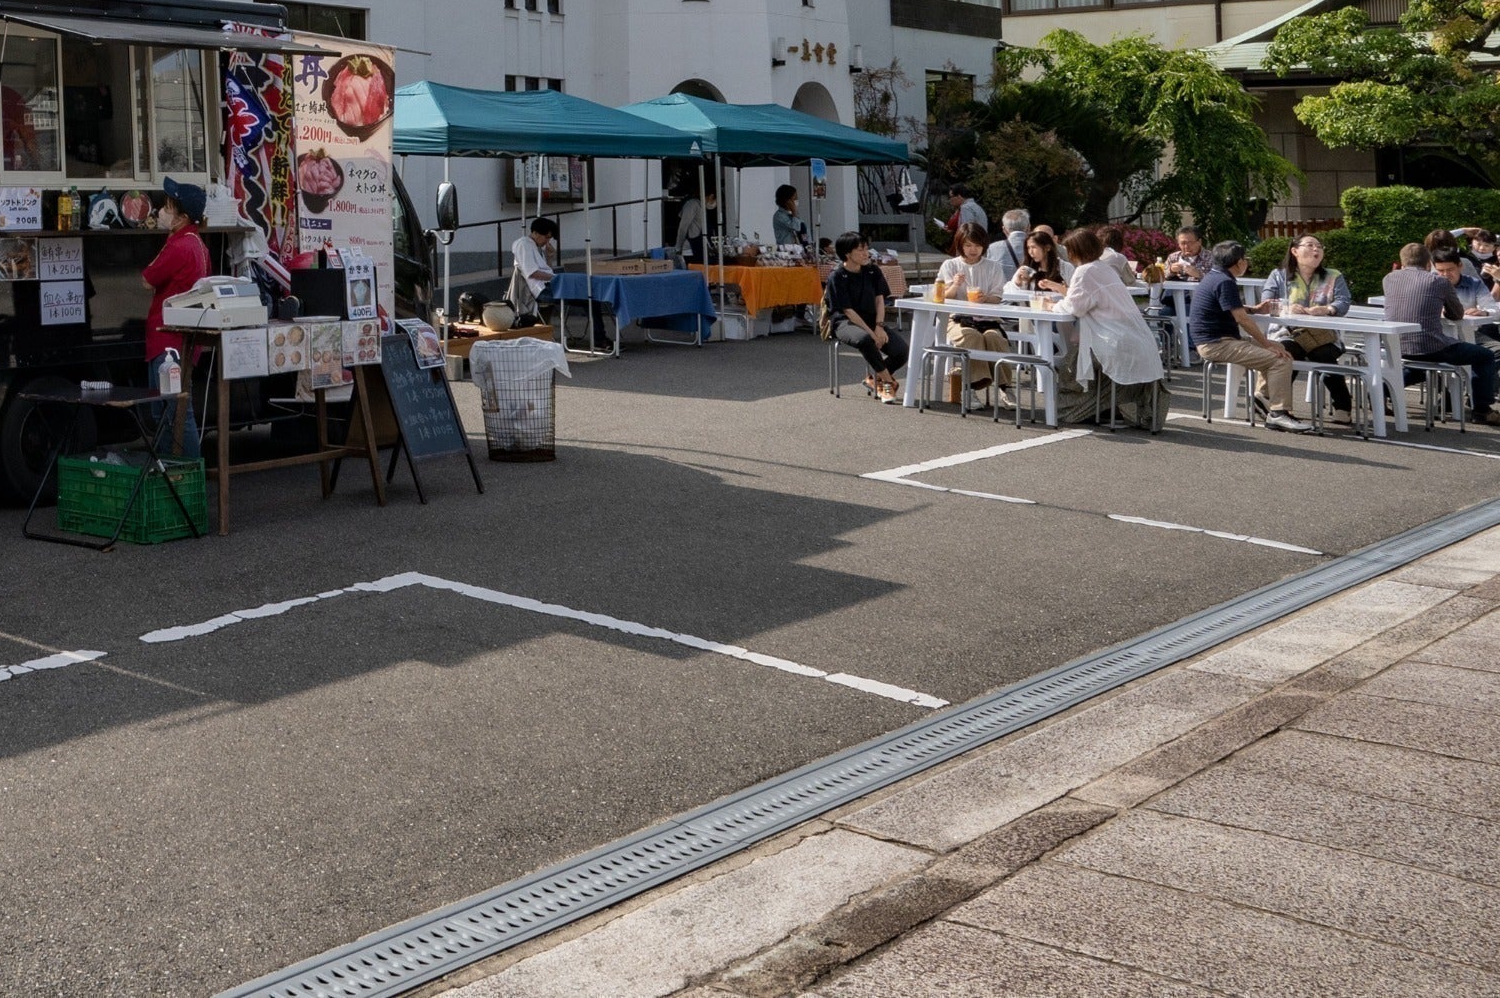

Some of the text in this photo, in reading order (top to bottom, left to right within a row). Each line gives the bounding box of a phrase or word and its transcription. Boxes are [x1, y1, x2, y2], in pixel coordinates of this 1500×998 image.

[356, 183, 386, 194] 大トロ丼
[329, 200, 357, 213] 1,800円
[349, 266, 370, 274] かき氷
[353, 307, 372, 316] 400円
